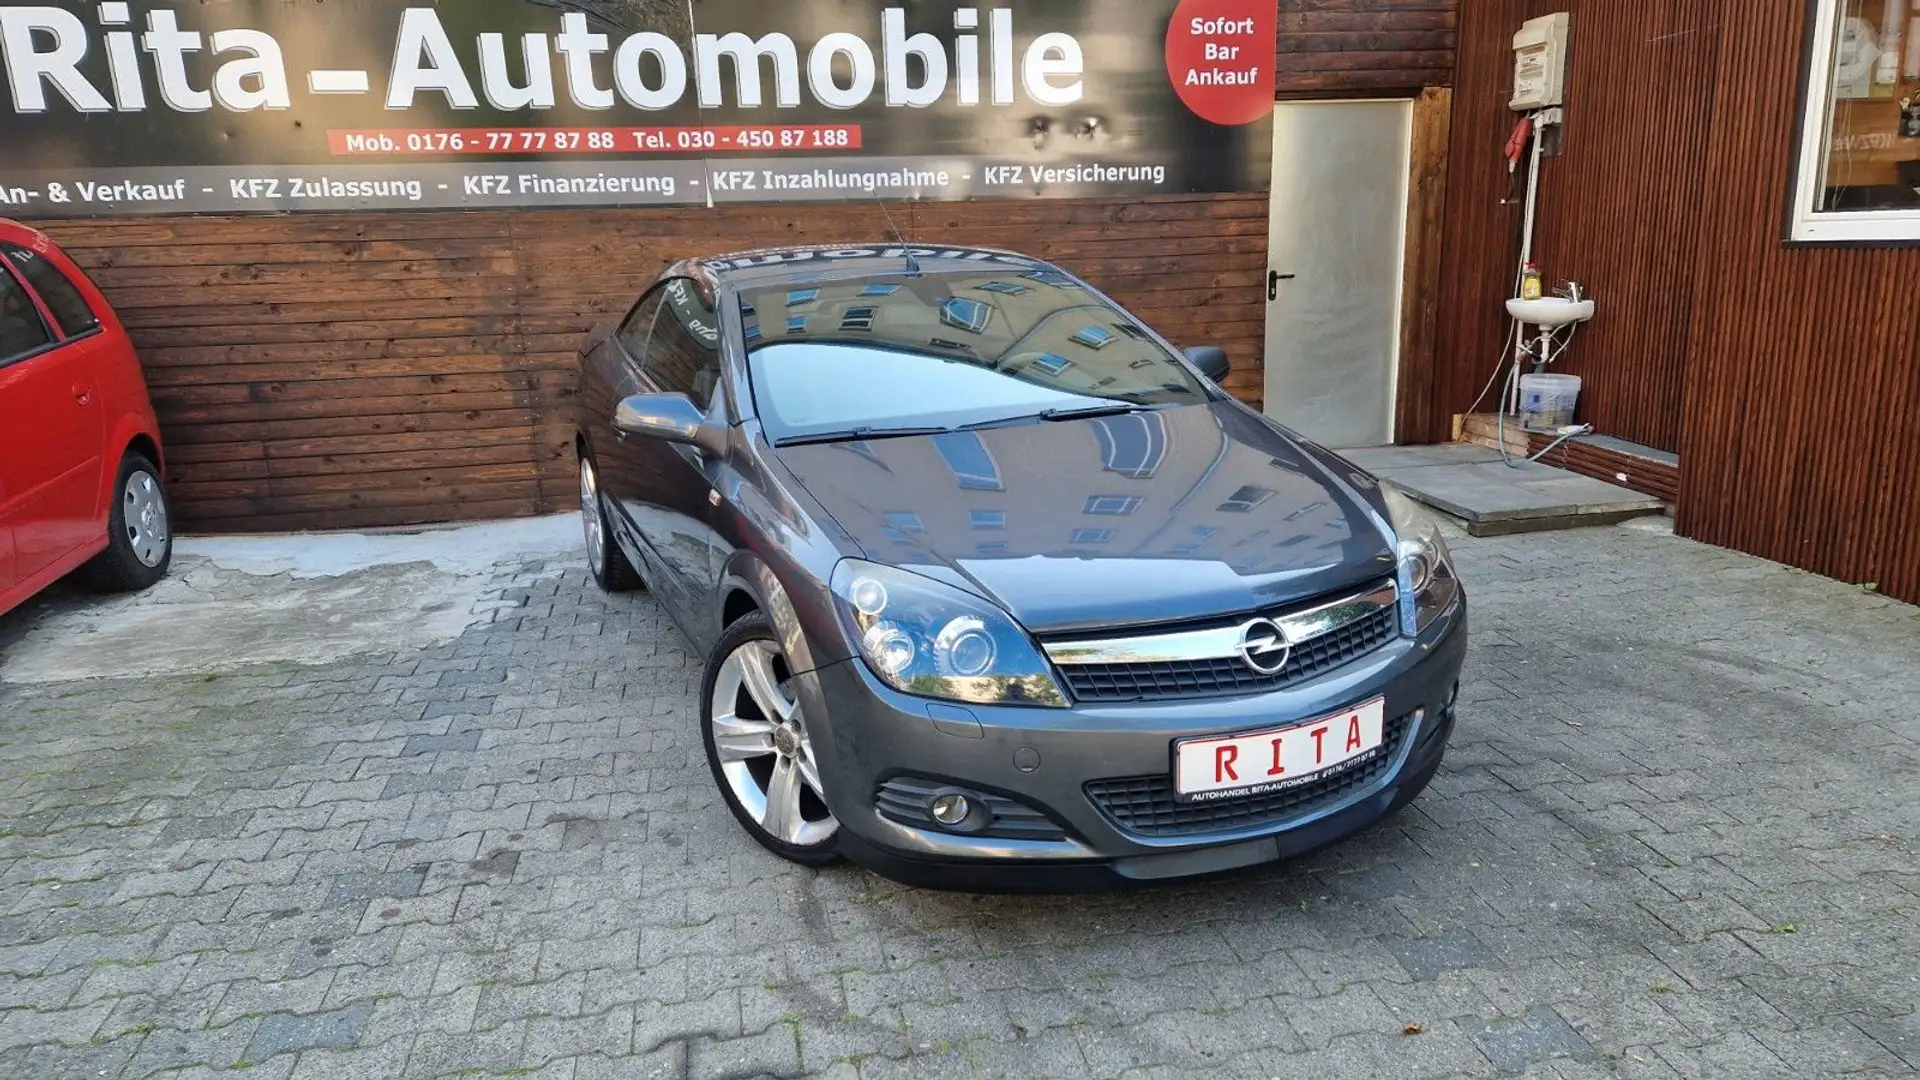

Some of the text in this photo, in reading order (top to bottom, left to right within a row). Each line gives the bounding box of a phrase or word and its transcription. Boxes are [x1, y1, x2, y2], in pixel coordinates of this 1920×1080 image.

[1190, 17, 1255, 35] Sofort
[0, 2, 291, 113] Rita
[384, 6, 1084, 111] Automobile
[1204, 43, 1240, 60] Bar
[1184, 67, 1259, 85] Ankauf
[345, 134, 401, 152] Mob.
[407, 133, 464, 151] 0176
[486, 132, 512, 150] 77
[519, 132, 546, 150] 77
[553, 132, 580, 149] 87
[587, 131, 615, 149] 88
[632, 131, 671, 149] Tel.
[677, 130, 715, 148] 030
[736, 130, 774, 148] 450
[780, 129, 804, 147] 87
[812, 128, 849, 147] 188
[0, 184, 39, 205] An-
[48, 181, 72, 204] &
[75, 178, 186, 202] Verkauf
[229, 178, 282, 198] KFZ
[287, 176, 422, 201] Zulassung
[463, 174, 511, 195] KFZ
[518, 173, 676, 197] Finanzierung
[712, 170, 756, 190] KFZ
[762, 167, 949, 192] Inzahlungnahme
[984, 165, 1023, 185] KFZ
[1030, 163, 1165, 185] Versicherung
[1191, 787, 1251, 801] AUTOHANDEL
